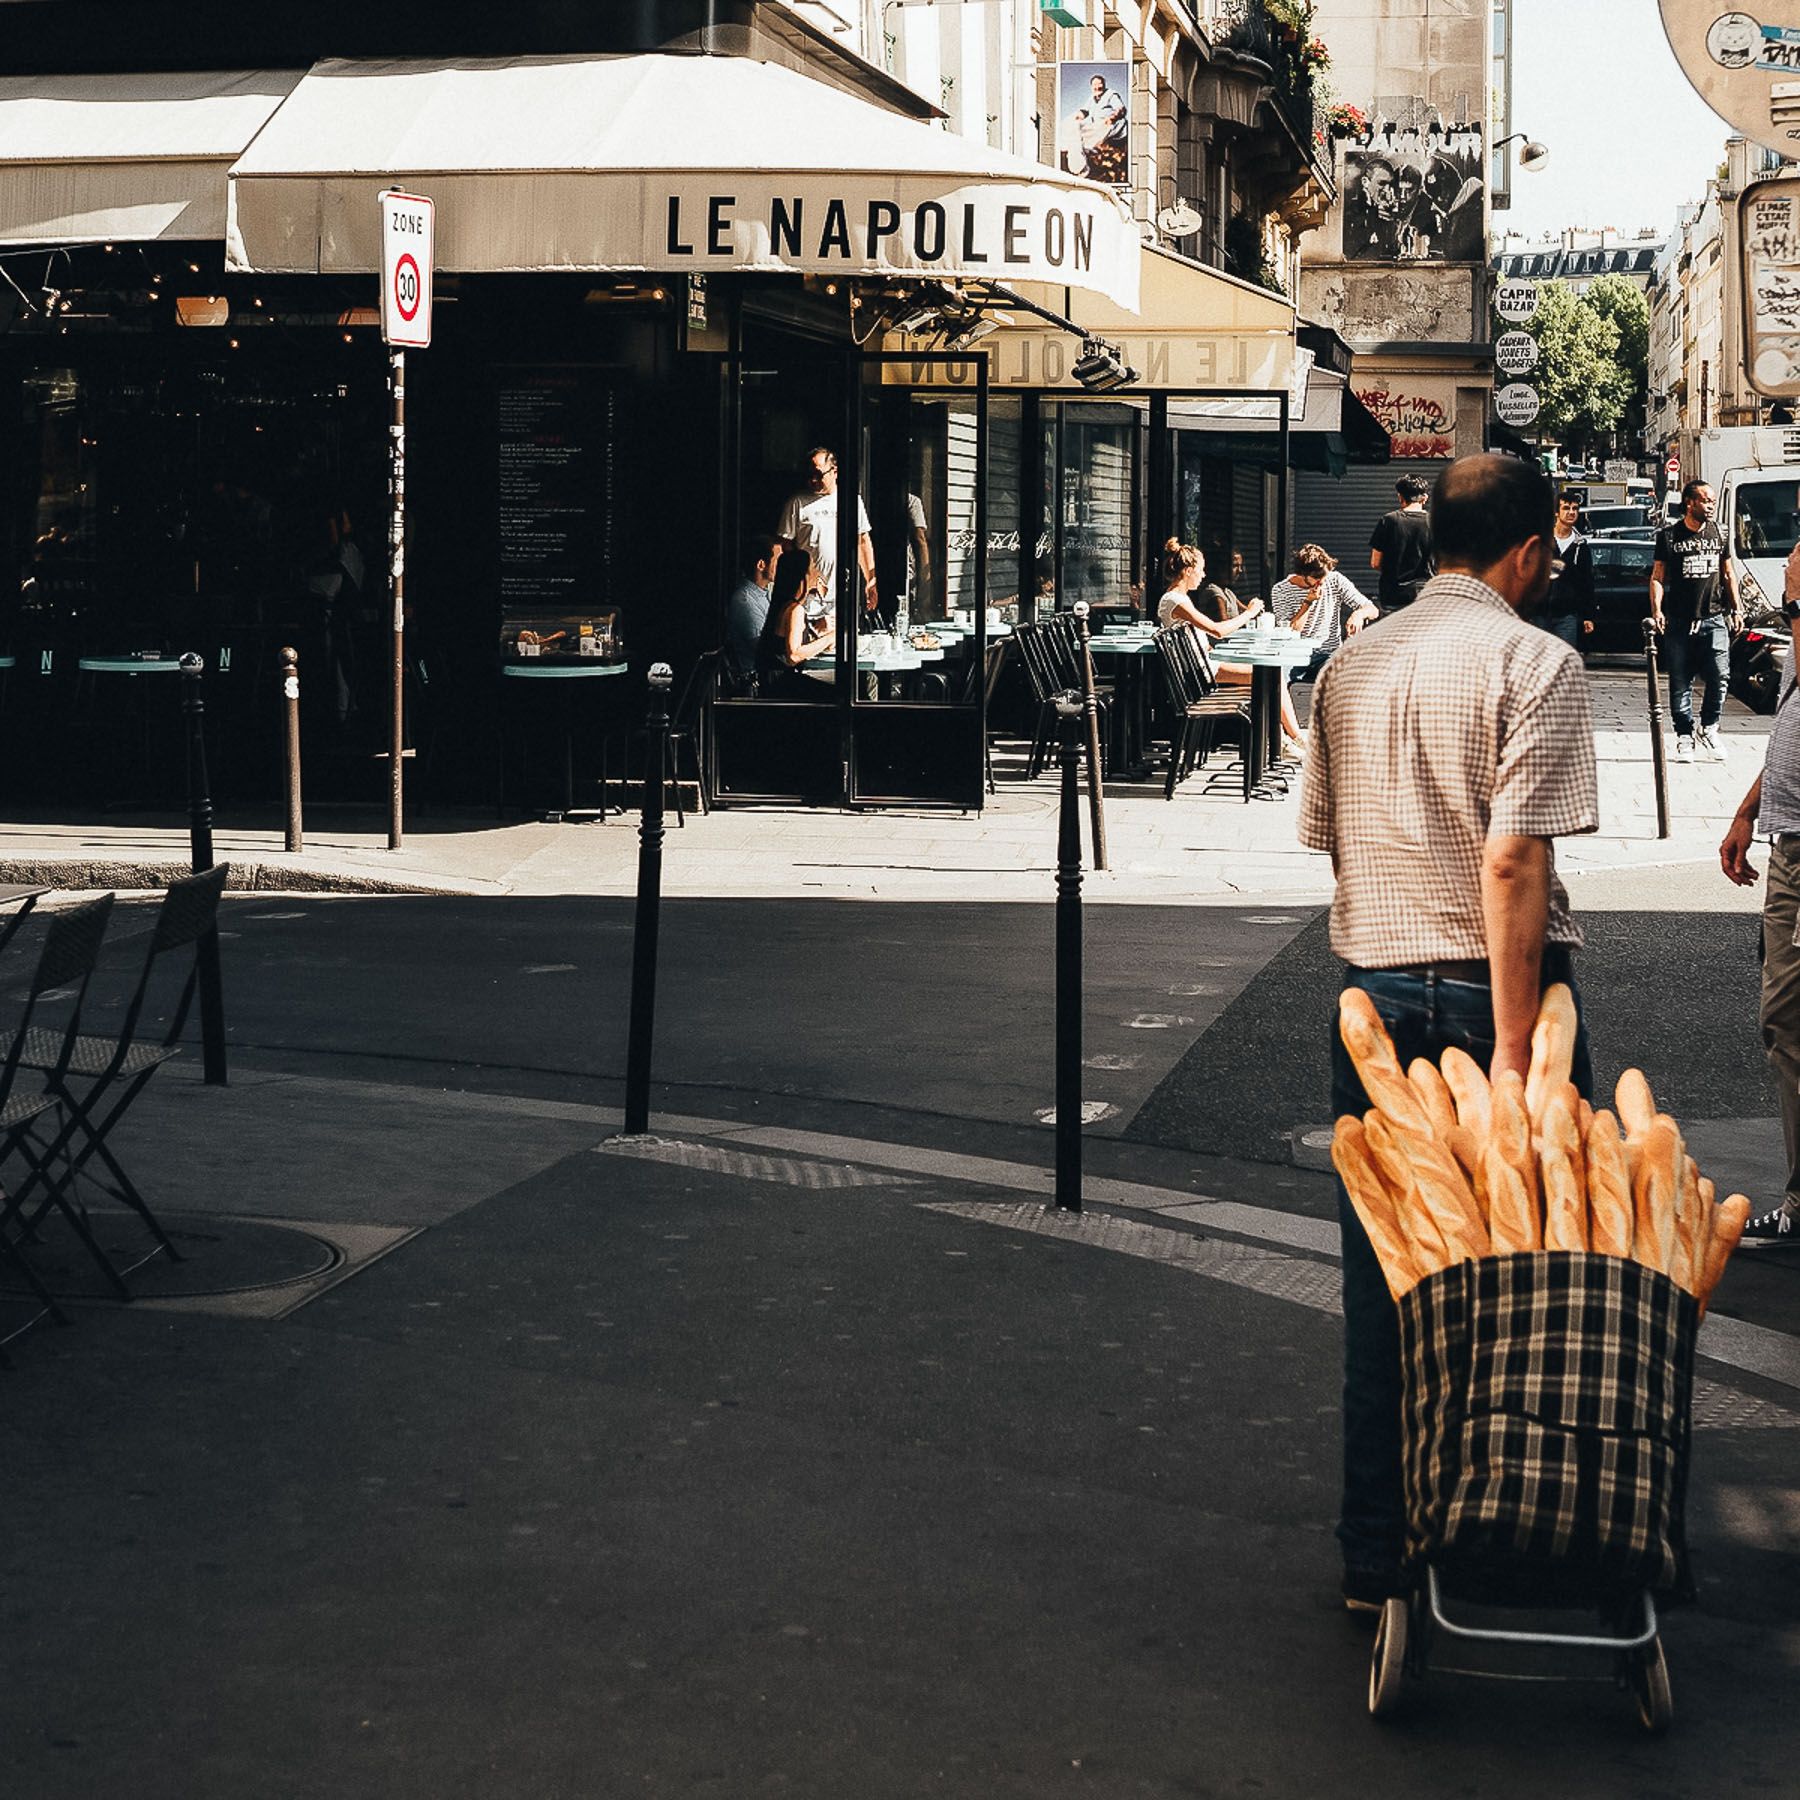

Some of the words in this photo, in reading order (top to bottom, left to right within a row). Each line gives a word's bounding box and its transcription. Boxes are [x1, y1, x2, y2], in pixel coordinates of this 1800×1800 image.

[392, 212, 423, 235] ZONE
[667, 196, 736, 255] LE
[769, 197, 1094, 272] NAPOLEON
[400, 272, 415, 302] 30
[1500, 288, 1537, 300] CAPRI
[1500, 301, 1535, 312] BAZAR
[1498, 347, 1531, 358] JOUETS
[1500, 358, 1535, 368] GADGETS
[41, 650, 52, 670] N
[219, 647, 231, 667] N
